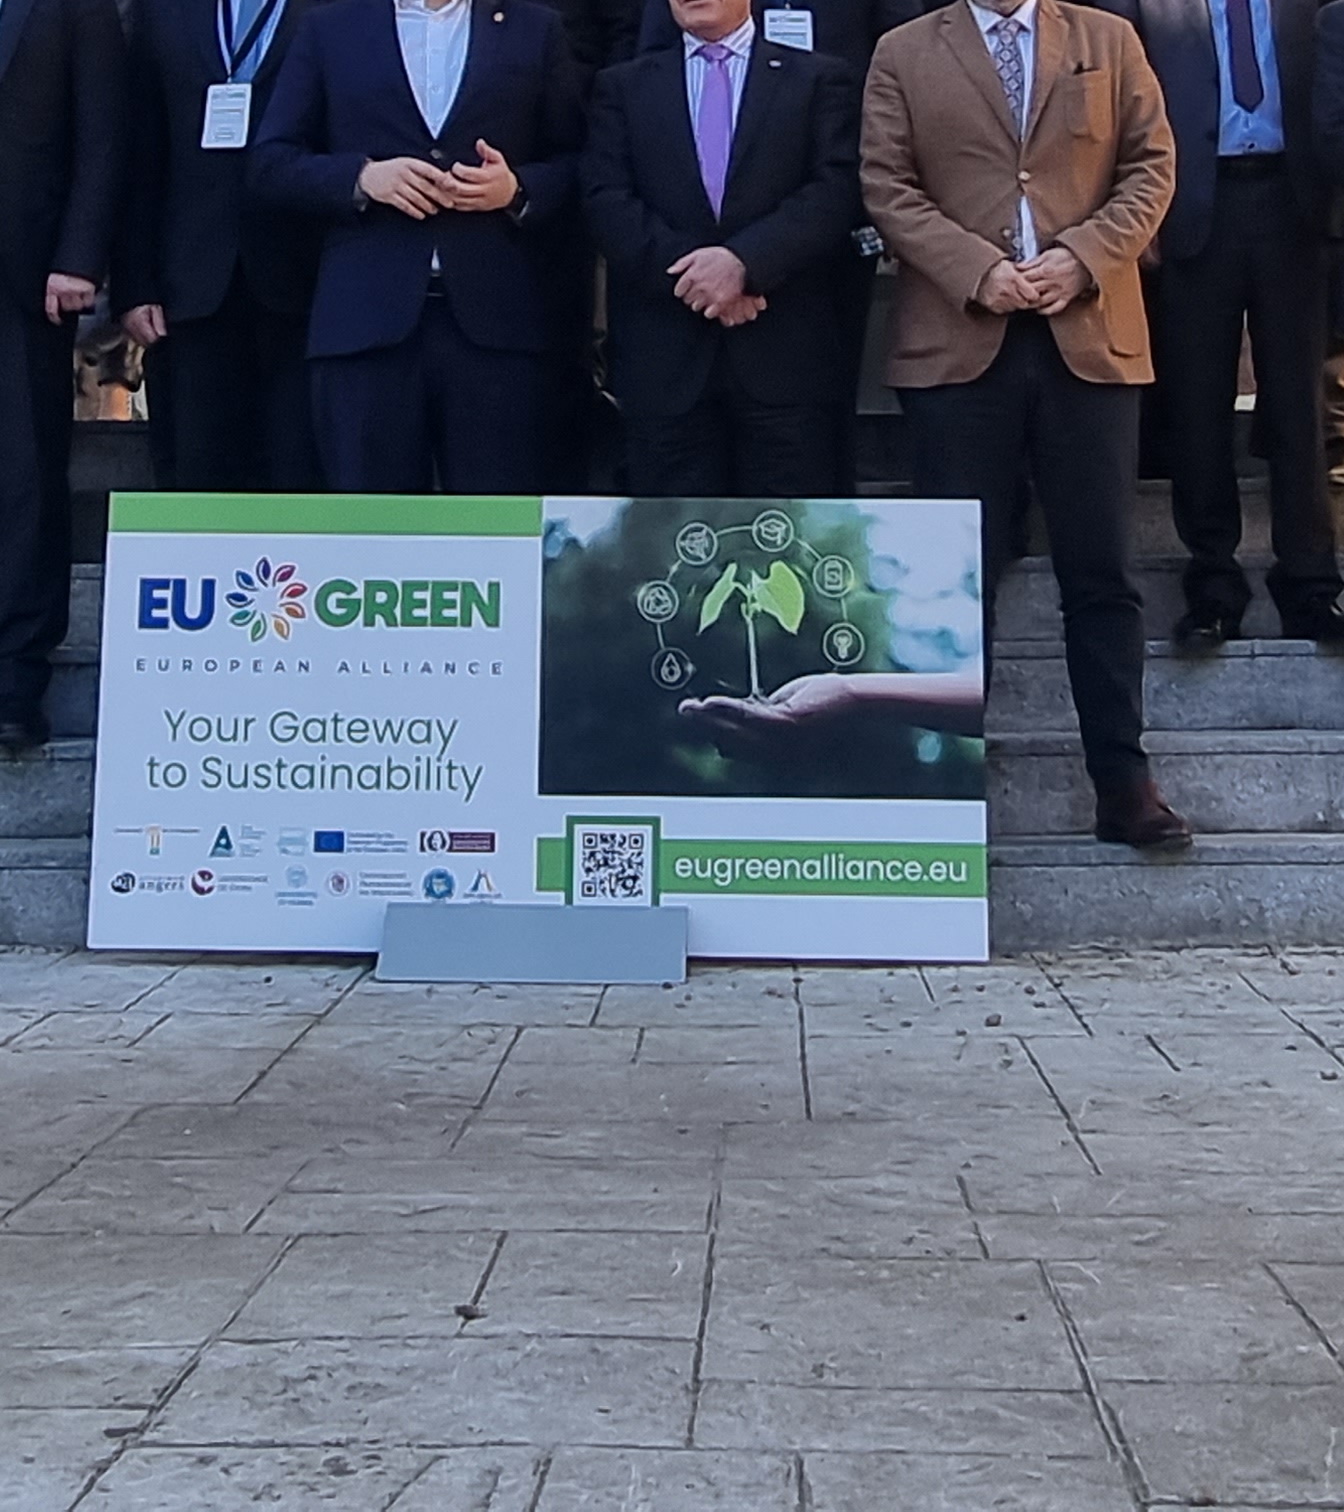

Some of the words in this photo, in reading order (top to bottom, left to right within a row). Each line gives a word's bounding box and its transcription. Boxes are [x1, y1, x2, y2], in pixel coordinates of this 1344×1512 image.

[137, 578, 217, 631] EU
[313, 578, 501, 628] GREEN
[135, 658, 311, 674] EUROPEAN
[337, 659, 504, 676] ALLIANCE
[163, 709, 257, 743] Your
[268, 709, 460, 758] Gateway
[146, 755, 188, 790] to
[200, 754, 484, 803] Sustainability
[673, 852, 969, 887] eugreenalliance.eu
